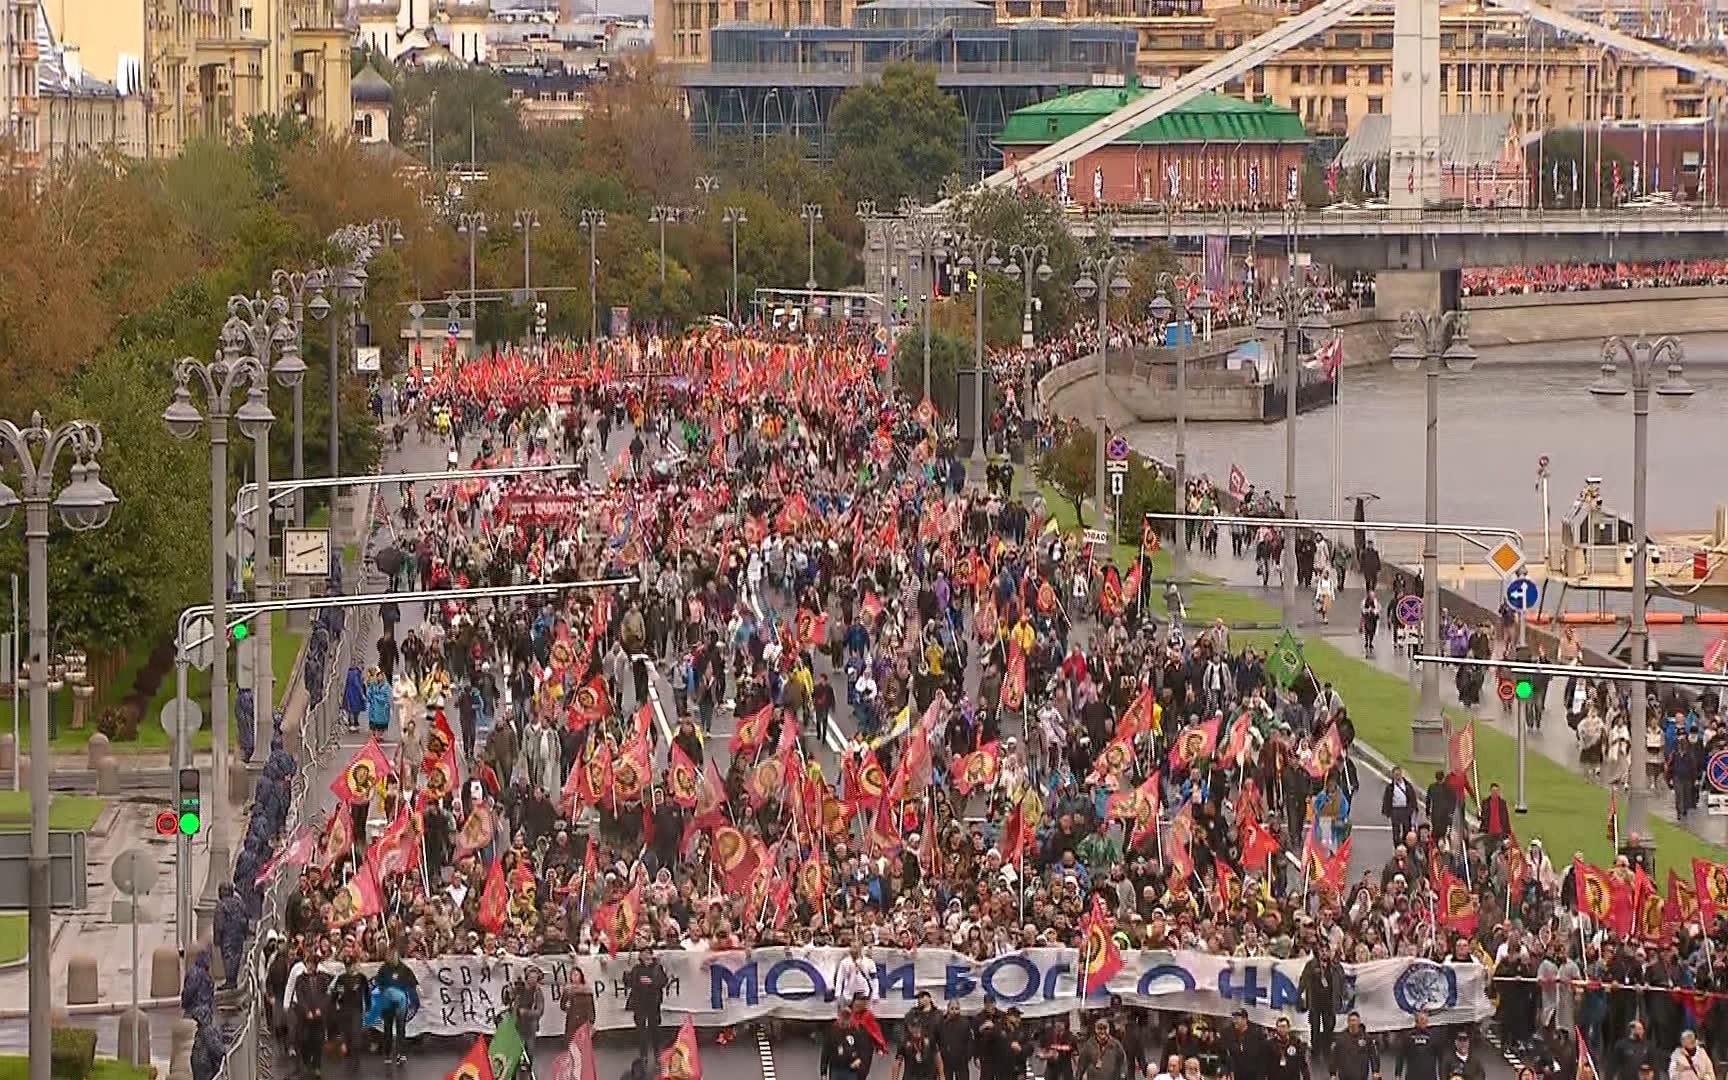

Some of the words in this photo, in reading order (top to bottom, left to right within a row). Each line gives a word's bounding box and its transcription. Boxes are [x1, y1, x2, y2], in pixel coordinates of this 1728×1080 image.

[438, 960, 567, 986] СВЯТЙ
[710, 959, 919, 1009] МОИ
[440, 974, 680, 1006] БЛАВРНЙ
